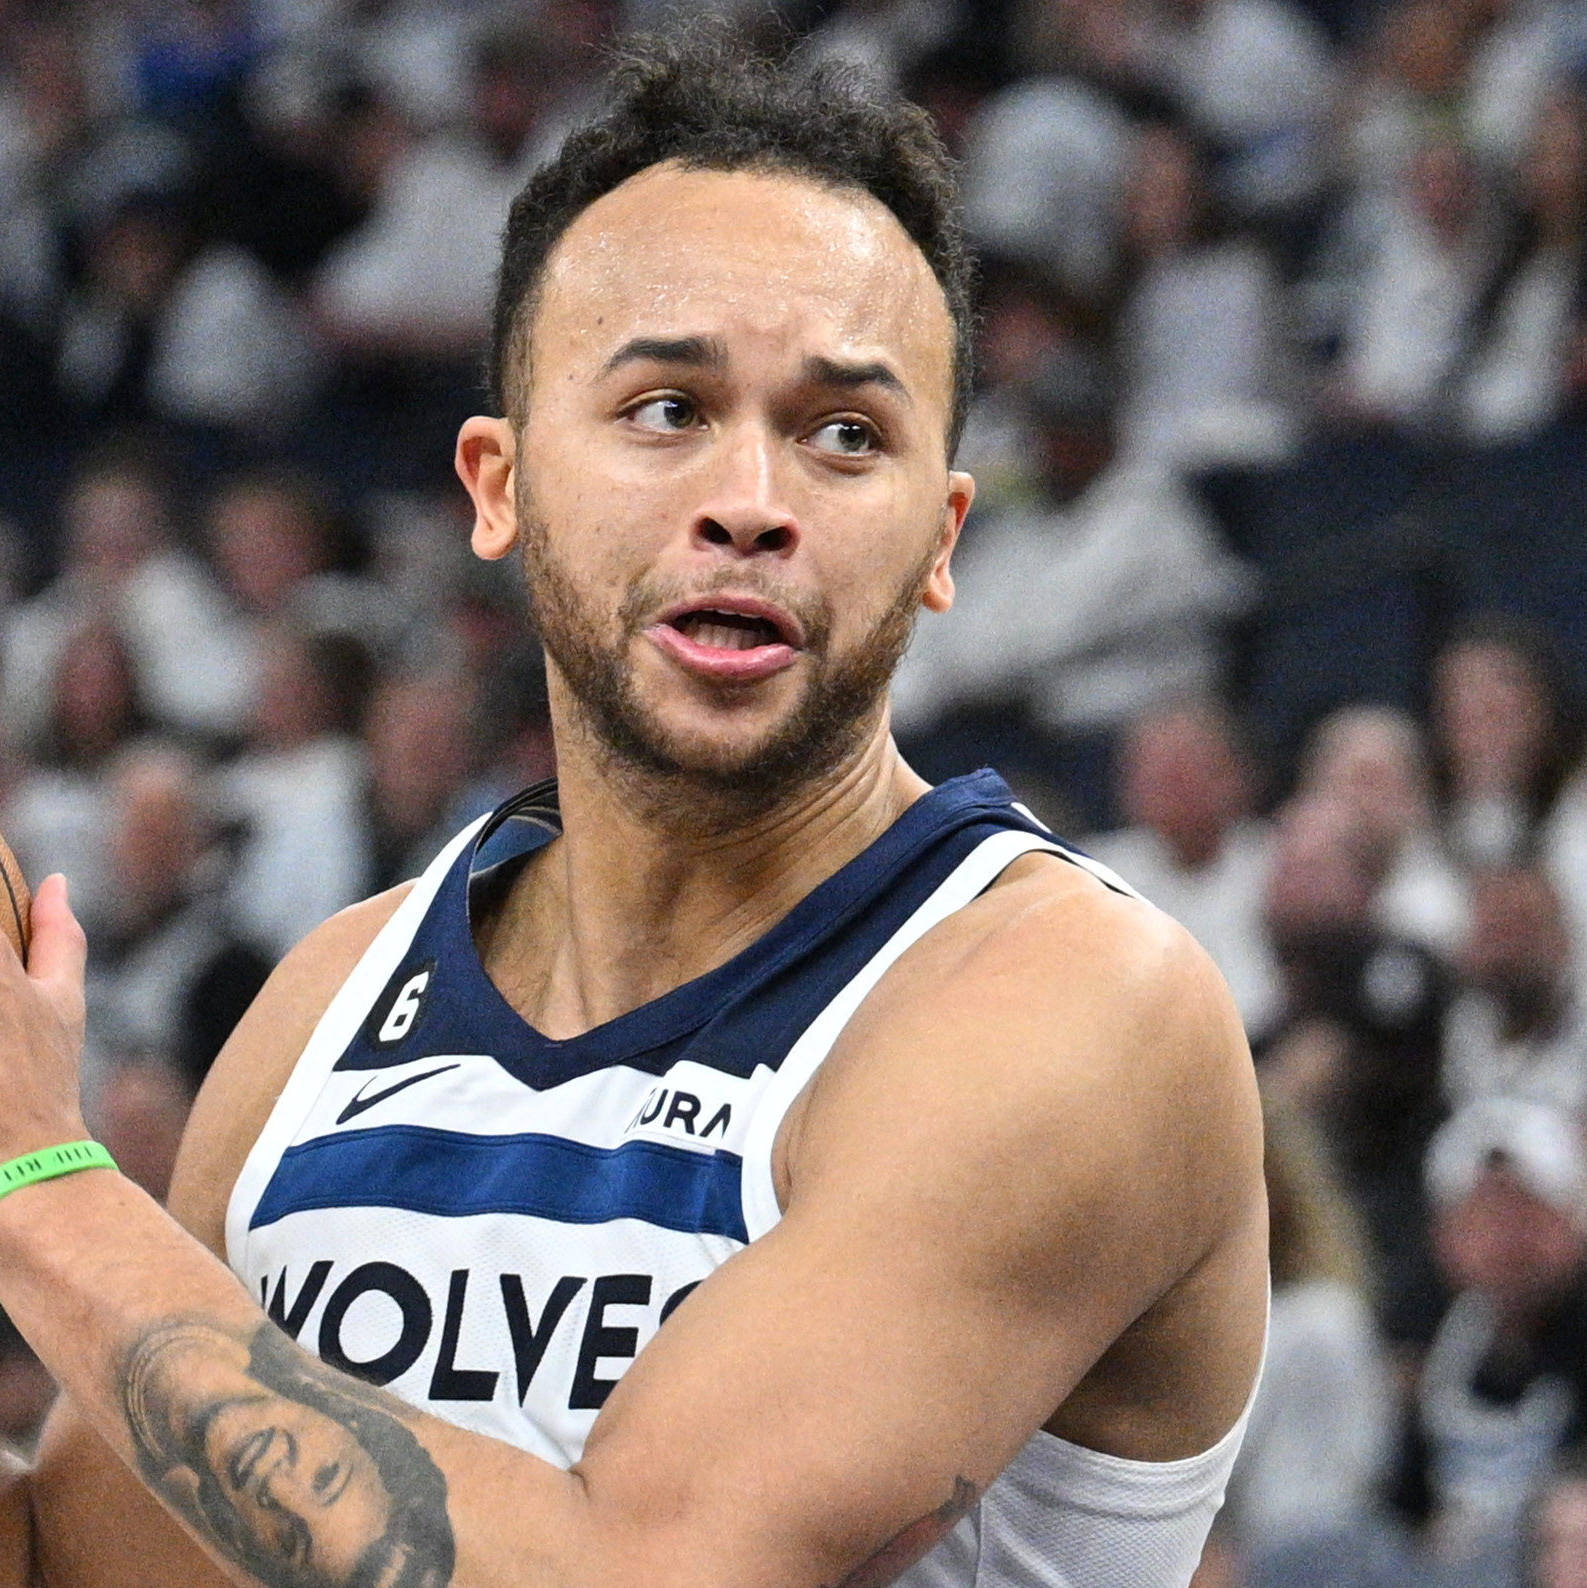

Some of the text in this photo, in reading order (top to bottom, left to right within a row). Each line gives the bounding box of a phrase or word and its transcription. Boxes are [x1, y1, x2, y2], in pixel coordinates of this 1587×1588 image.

[378, 970, 430, 1043] 6
[624, 1086, 732, 1140] URA
[260, 1259, 708, 1411] WOLVE
